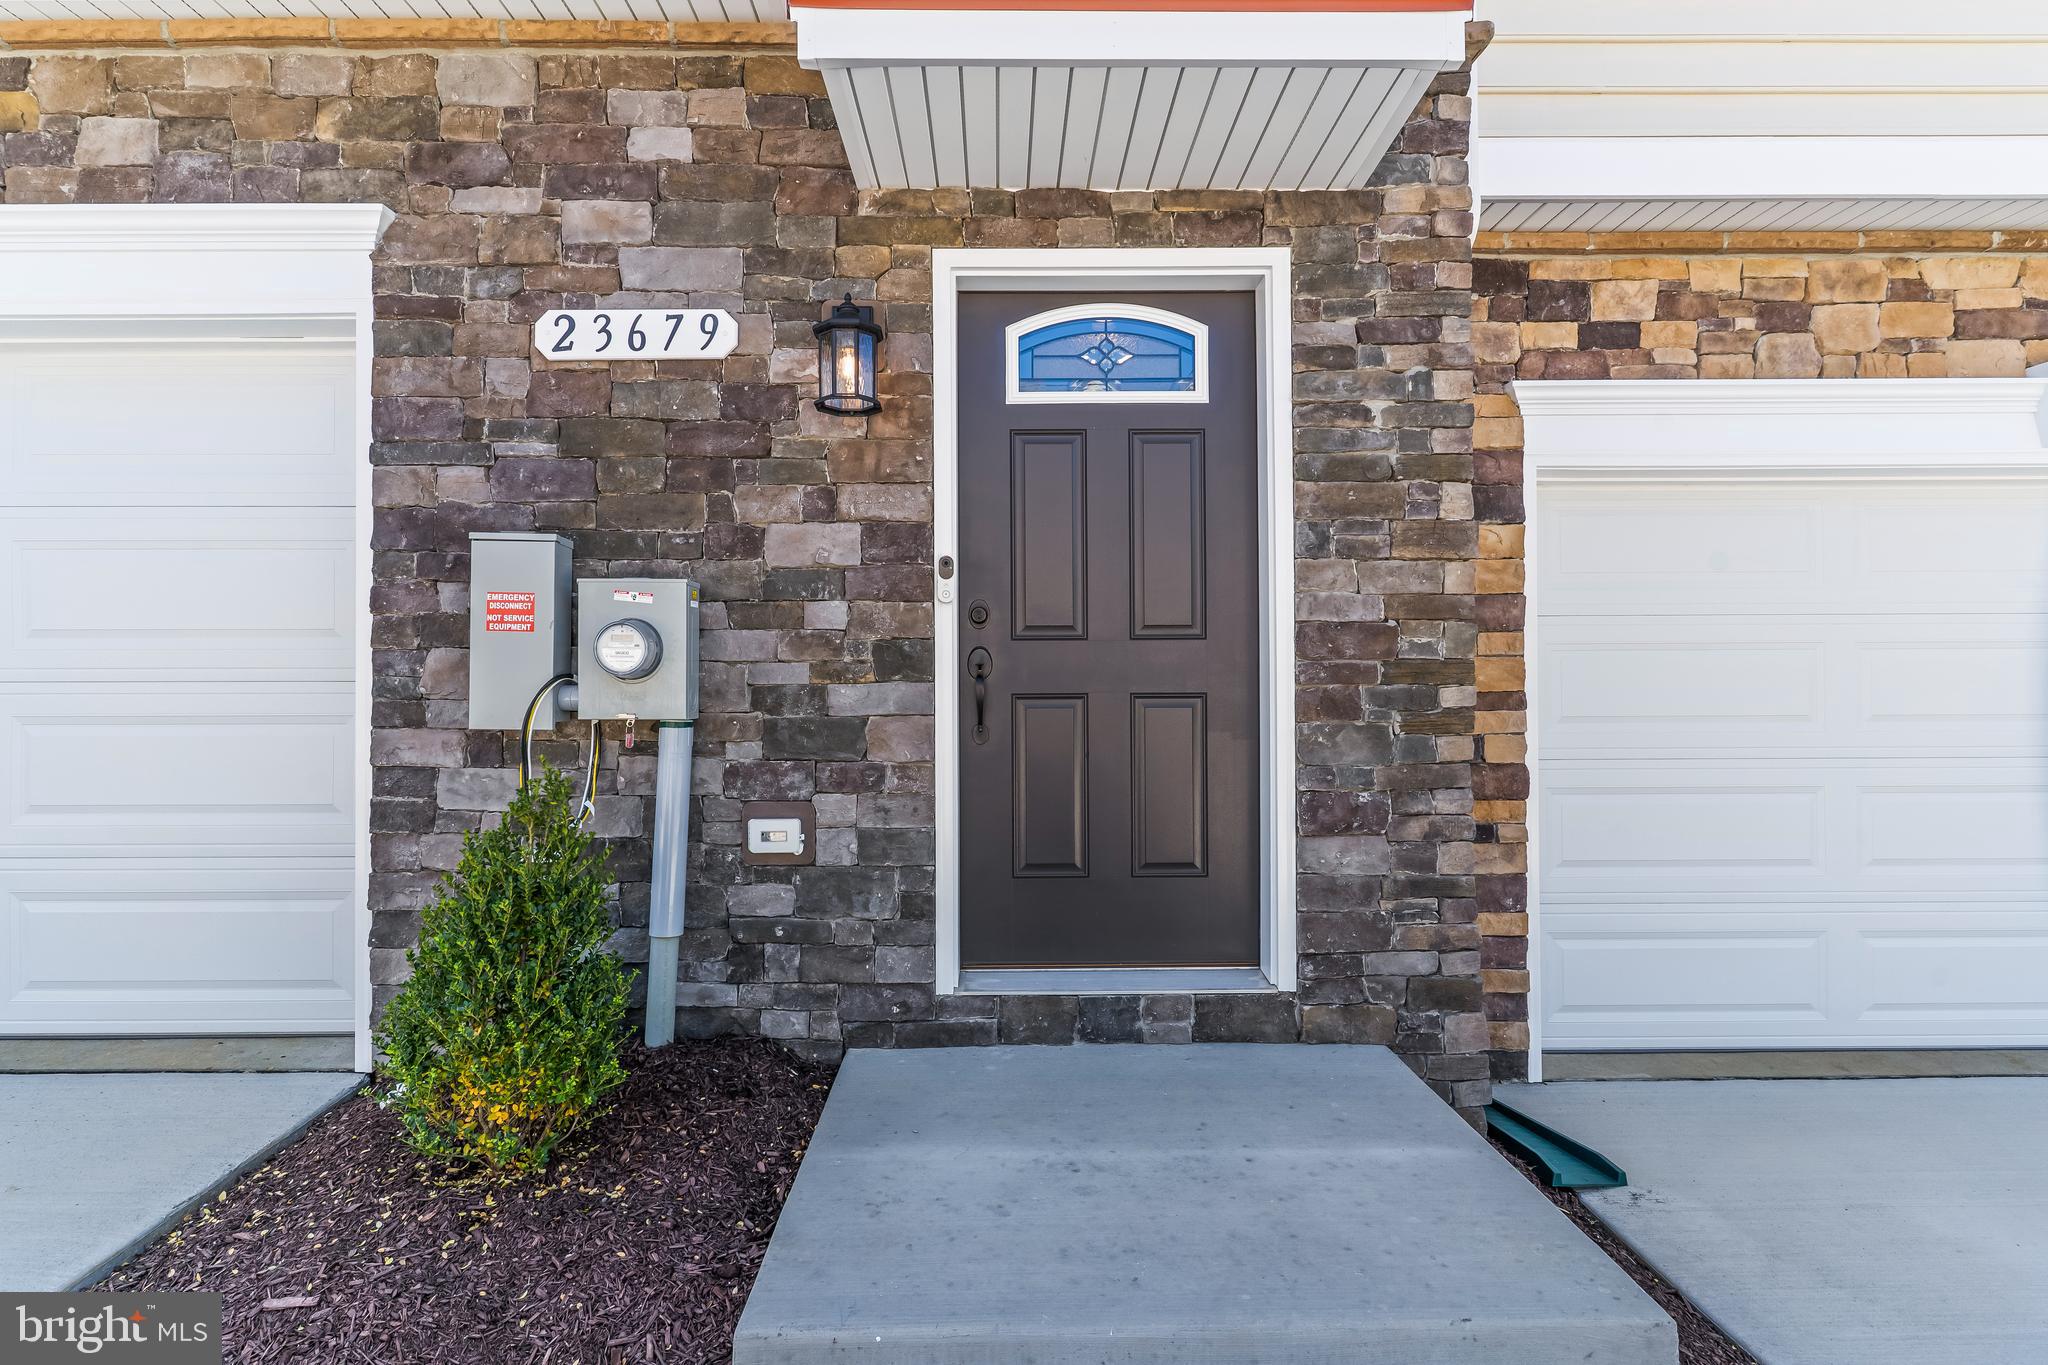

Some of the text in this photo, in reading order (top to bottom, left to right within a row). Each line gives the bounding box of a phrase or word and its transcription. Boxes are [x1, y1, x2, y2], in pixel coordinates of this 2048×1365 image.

[552, 313, 719, 353] 23679
[487, 593, 535, 602] EMERGENCY
[489, 602, 532, 610] DISCONNECT
[487, 614, 534, 622] NOT SERVICE
[489, 623, 531, 631] EQUIPMENT
